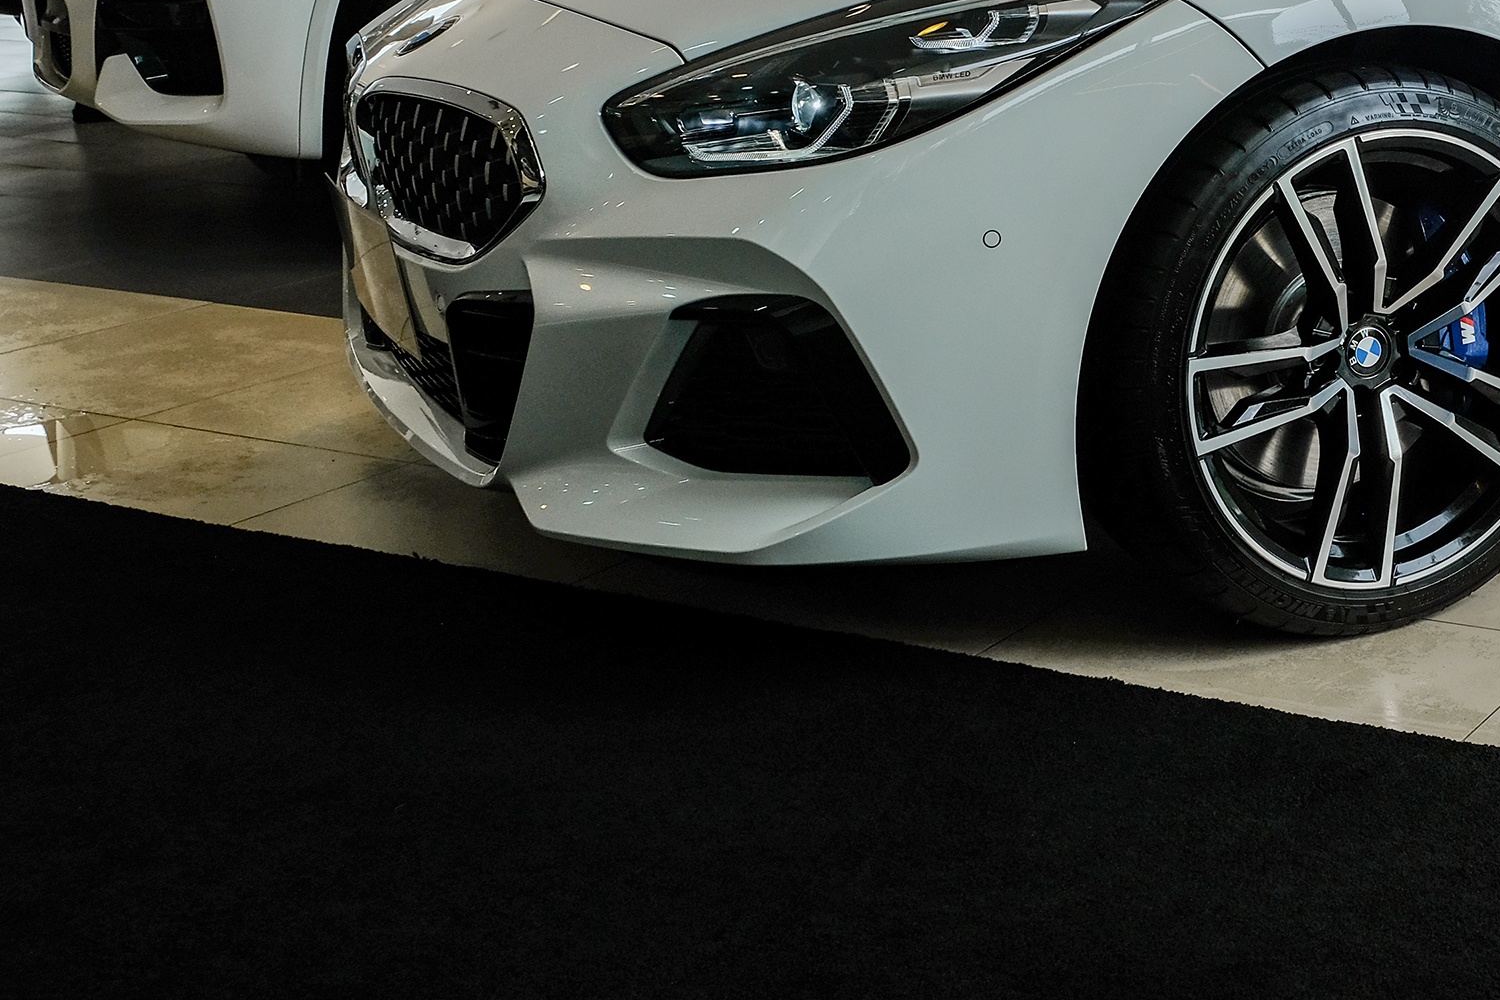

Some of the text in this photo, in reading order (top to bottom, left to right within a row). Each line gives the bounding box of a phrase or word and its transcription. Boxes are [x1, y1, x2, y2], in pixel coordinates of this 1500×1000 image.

[932, 70, 971, 81] BMW LED
[1287, 128, 1322, 151] EXTRA LOAD
[1349, 329, 1369, 366] BMW
